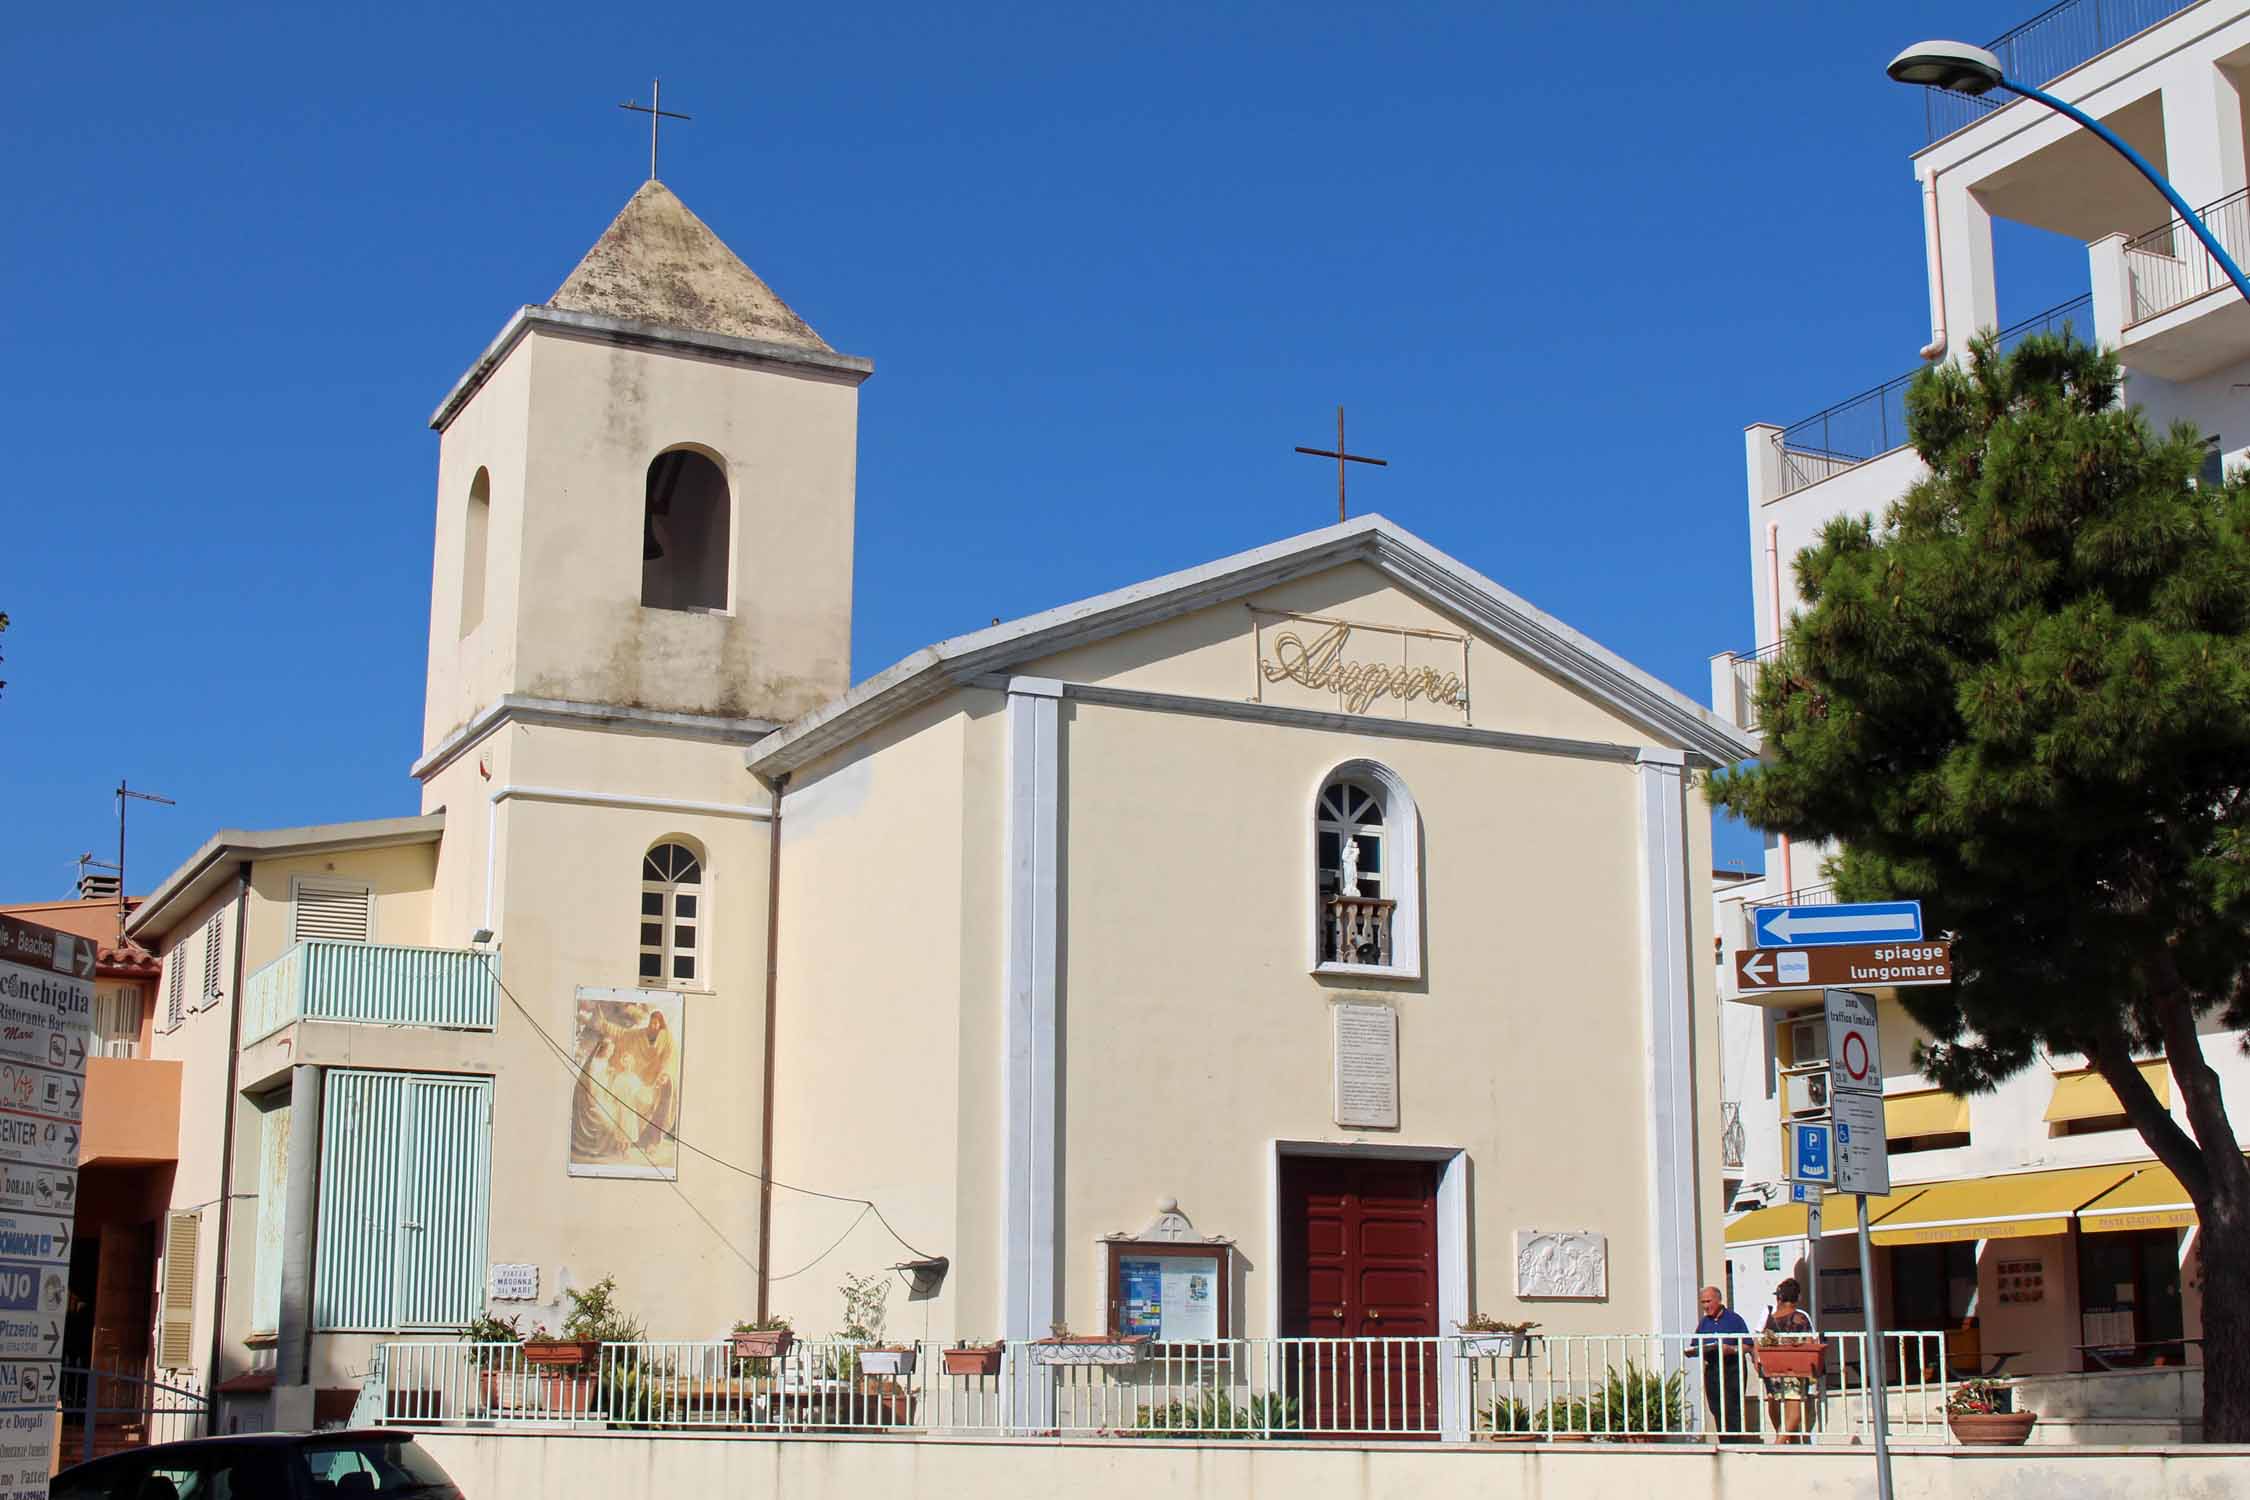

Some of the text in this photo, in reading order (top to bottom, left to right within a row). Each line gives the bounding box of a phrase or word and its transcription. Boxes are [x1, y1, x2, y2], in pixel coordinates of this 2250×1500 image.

[17, 930, 53, 959] Beaches
[1874, 946, 1944, 962] spiagge
[1850, 965, 1945, 980] lungomare
[1830, 1010, 1852, 1024] traffico
[1808, 1132, 1818, 1147] P
[6, 1178, 34, 1196] DORADA
[0, 1320, 39, 1337] Pizzeria
[14, 1413, 43, 1432] Dorgali
